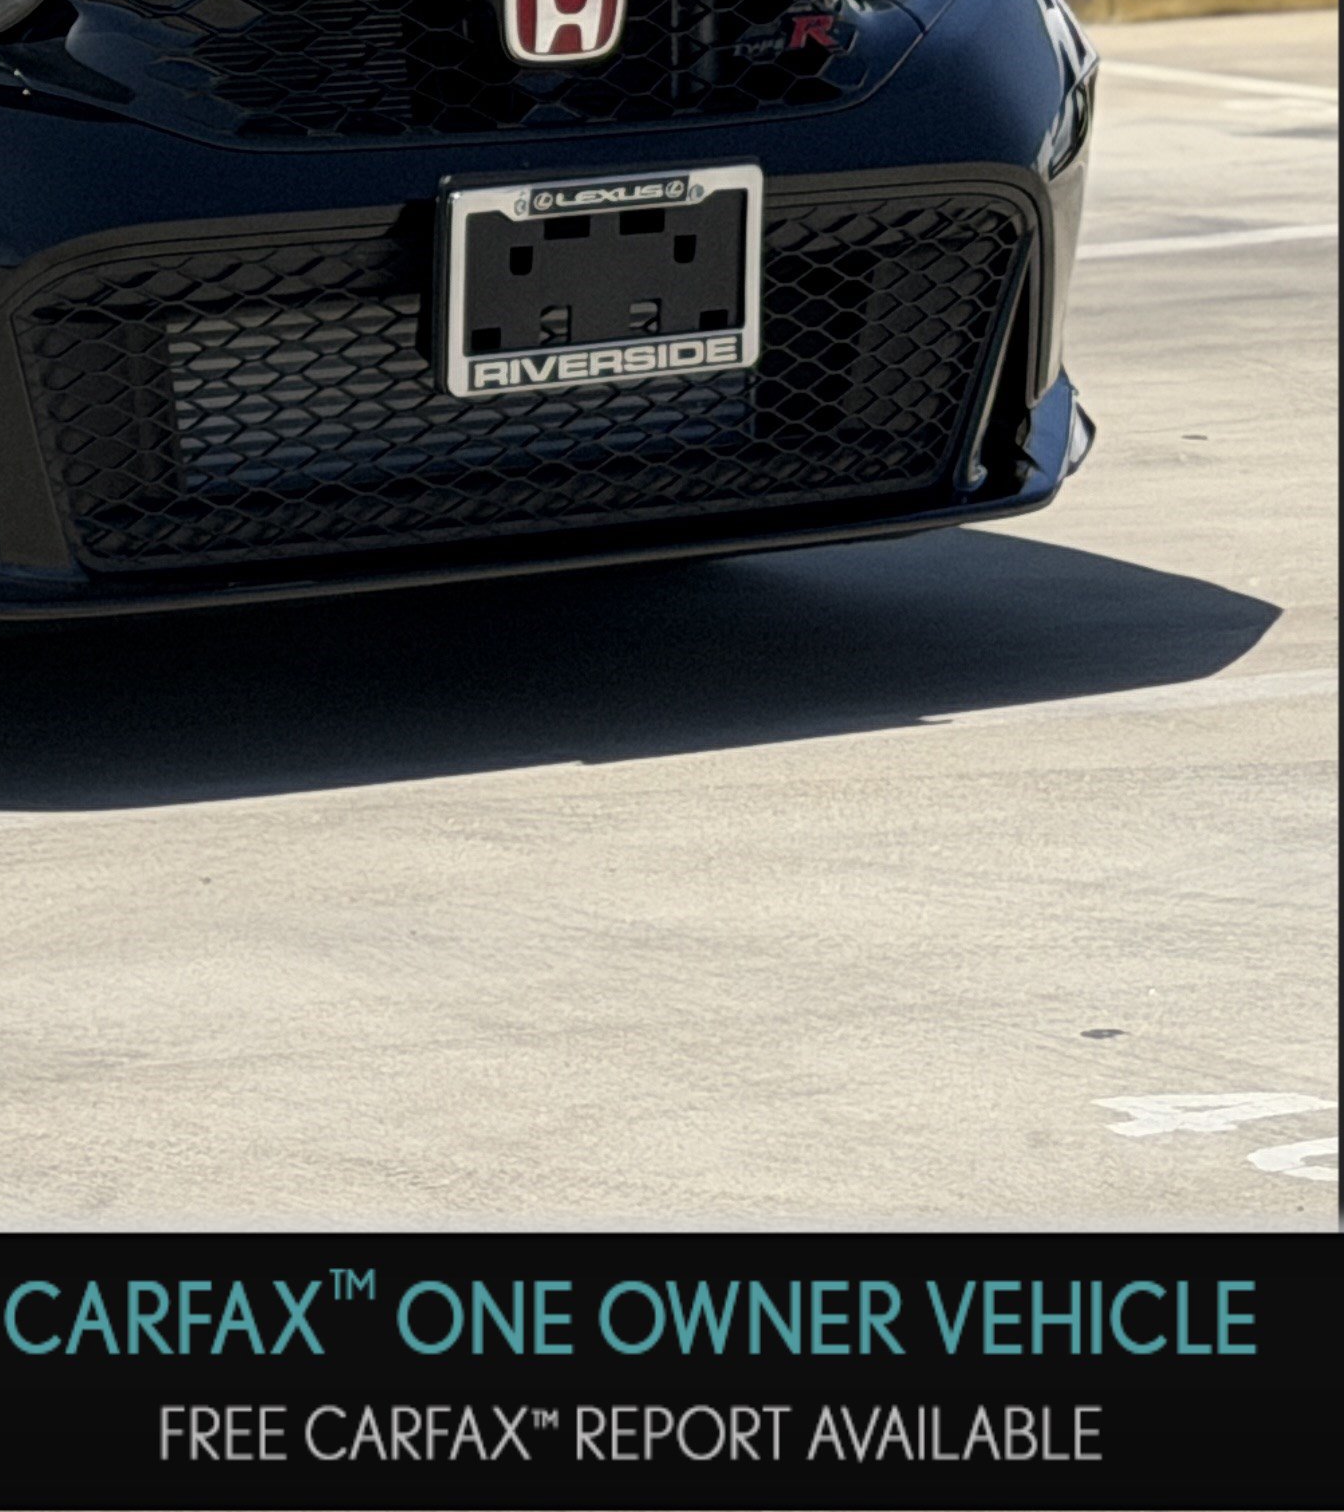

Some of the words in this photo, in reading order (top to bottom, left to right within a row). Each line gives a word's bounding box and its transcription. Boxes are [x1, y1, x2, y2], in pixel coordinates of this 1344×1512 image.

[787, 13, 840, 51] R
[555, 183, 665, 208] LEXUS
[472, 335, 740, 389] RIVERSIDE
